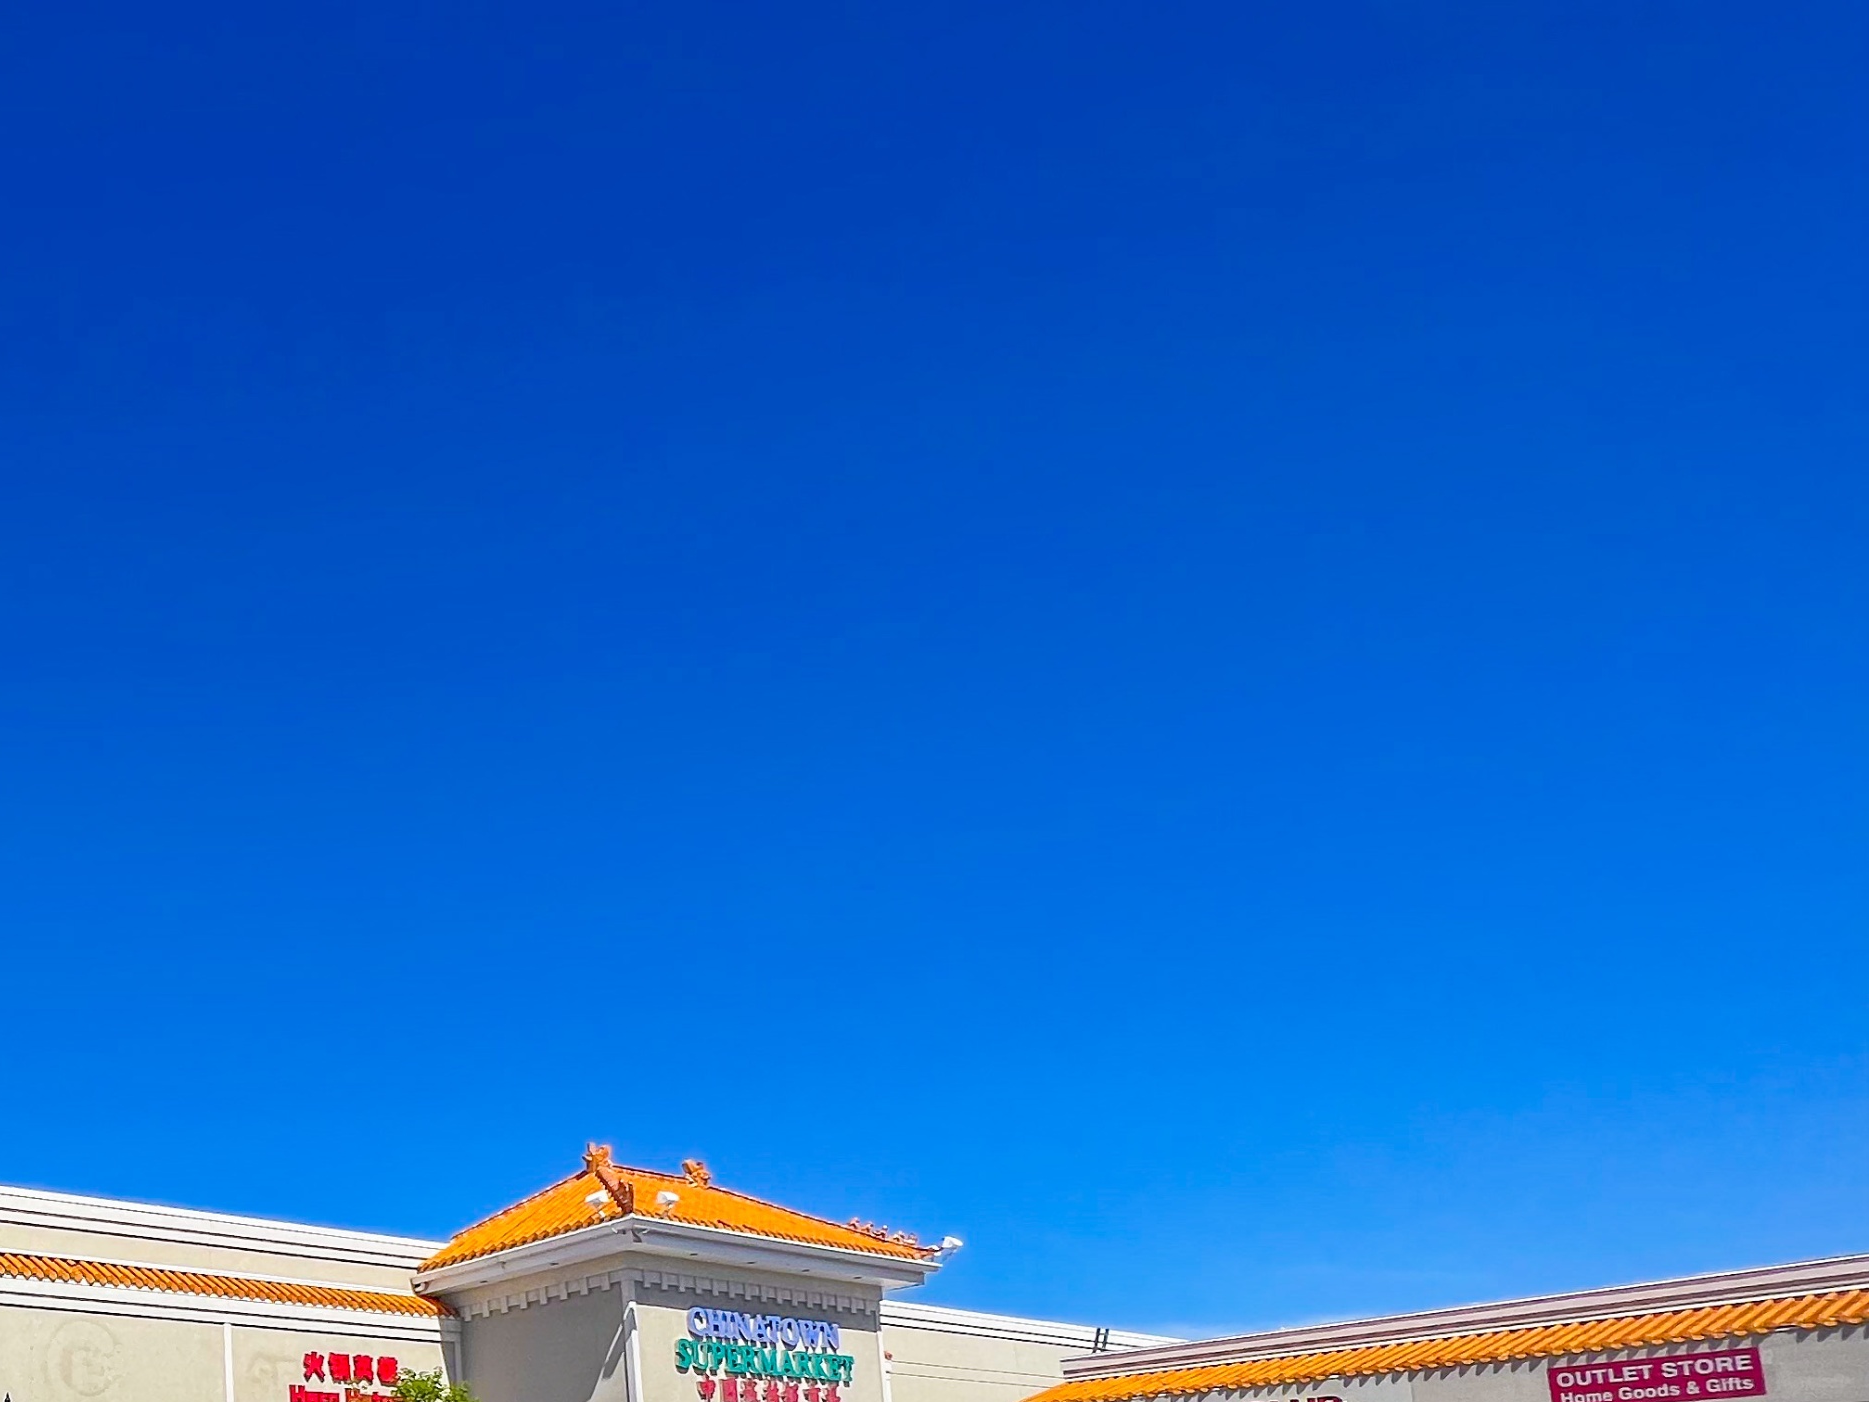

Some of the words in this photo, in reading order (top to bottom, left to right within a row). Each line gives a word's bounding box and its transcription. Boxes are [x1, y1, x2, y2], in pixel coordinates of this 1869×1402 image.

[687, 1307, 840, 1350] CHINATOWN
[675, 1339, 855, 1384] SUPERMARKET
[1556, 1364, 1653, 1389] OUTLET
[1661, 1355, 1754, 1379] STORE
[1618, 1383, 1680, 1401] Goods
[1686, 1380, 1700, 1395] &
[1705, 1377, 1755, 1393] Gifts
